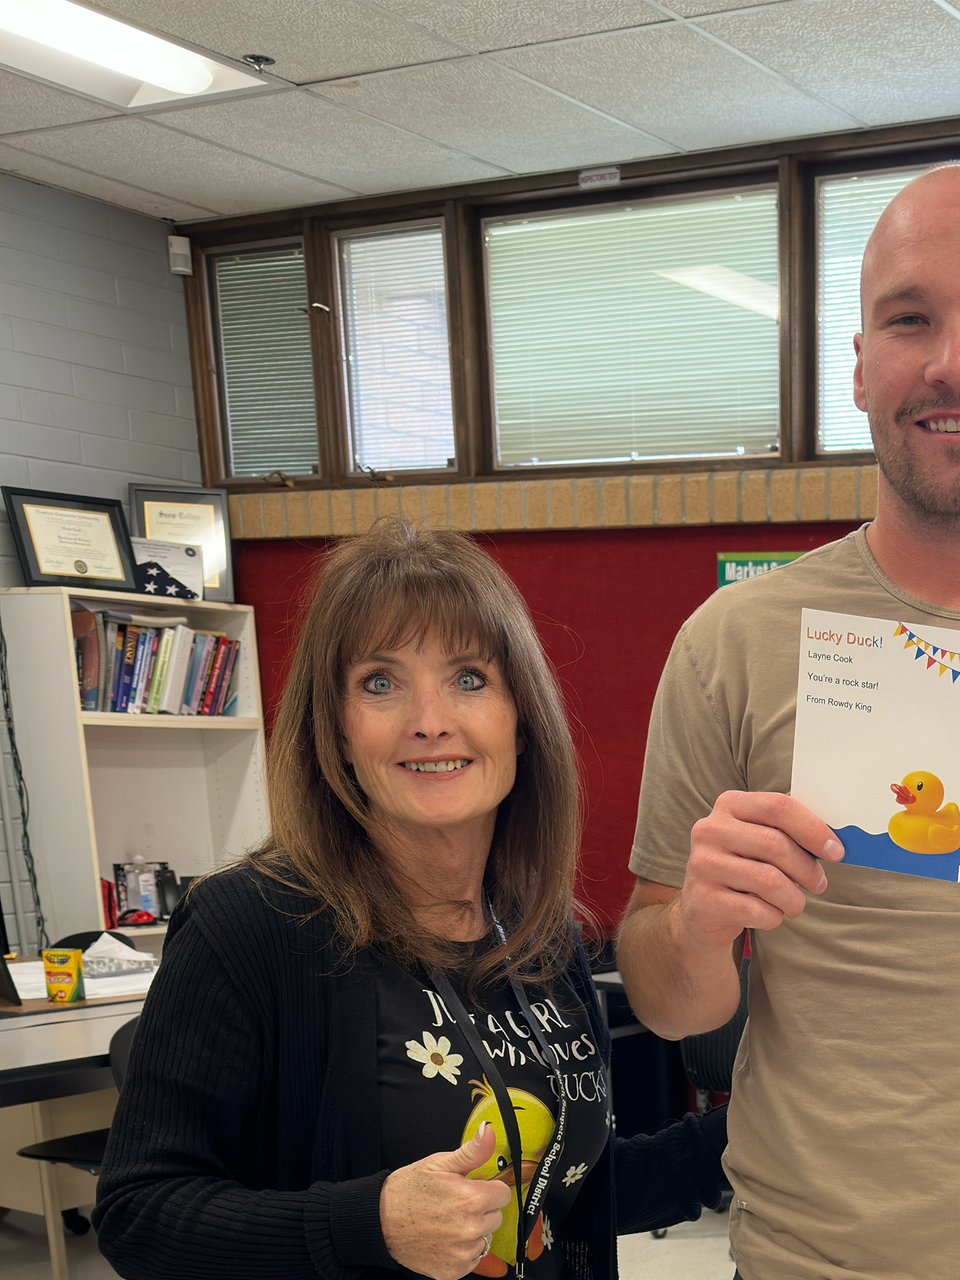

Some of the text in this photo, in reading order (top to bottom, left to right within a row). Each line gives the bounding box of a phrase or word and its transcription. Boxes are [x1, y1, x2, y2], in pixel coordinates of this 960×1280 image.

[806, 626, 883, 649] Lucky Duck!
[808, 650, 853, 664] Layne Cook
[807, 672, 879, 691] You're a rock star!
[806, 695, 872, 714] From Rowdy King
[487, 1014, 510, 1041] A
[504, 998, 571, 1039] GRL
[527, 1068, 567, 1216] North Sanpete School District
